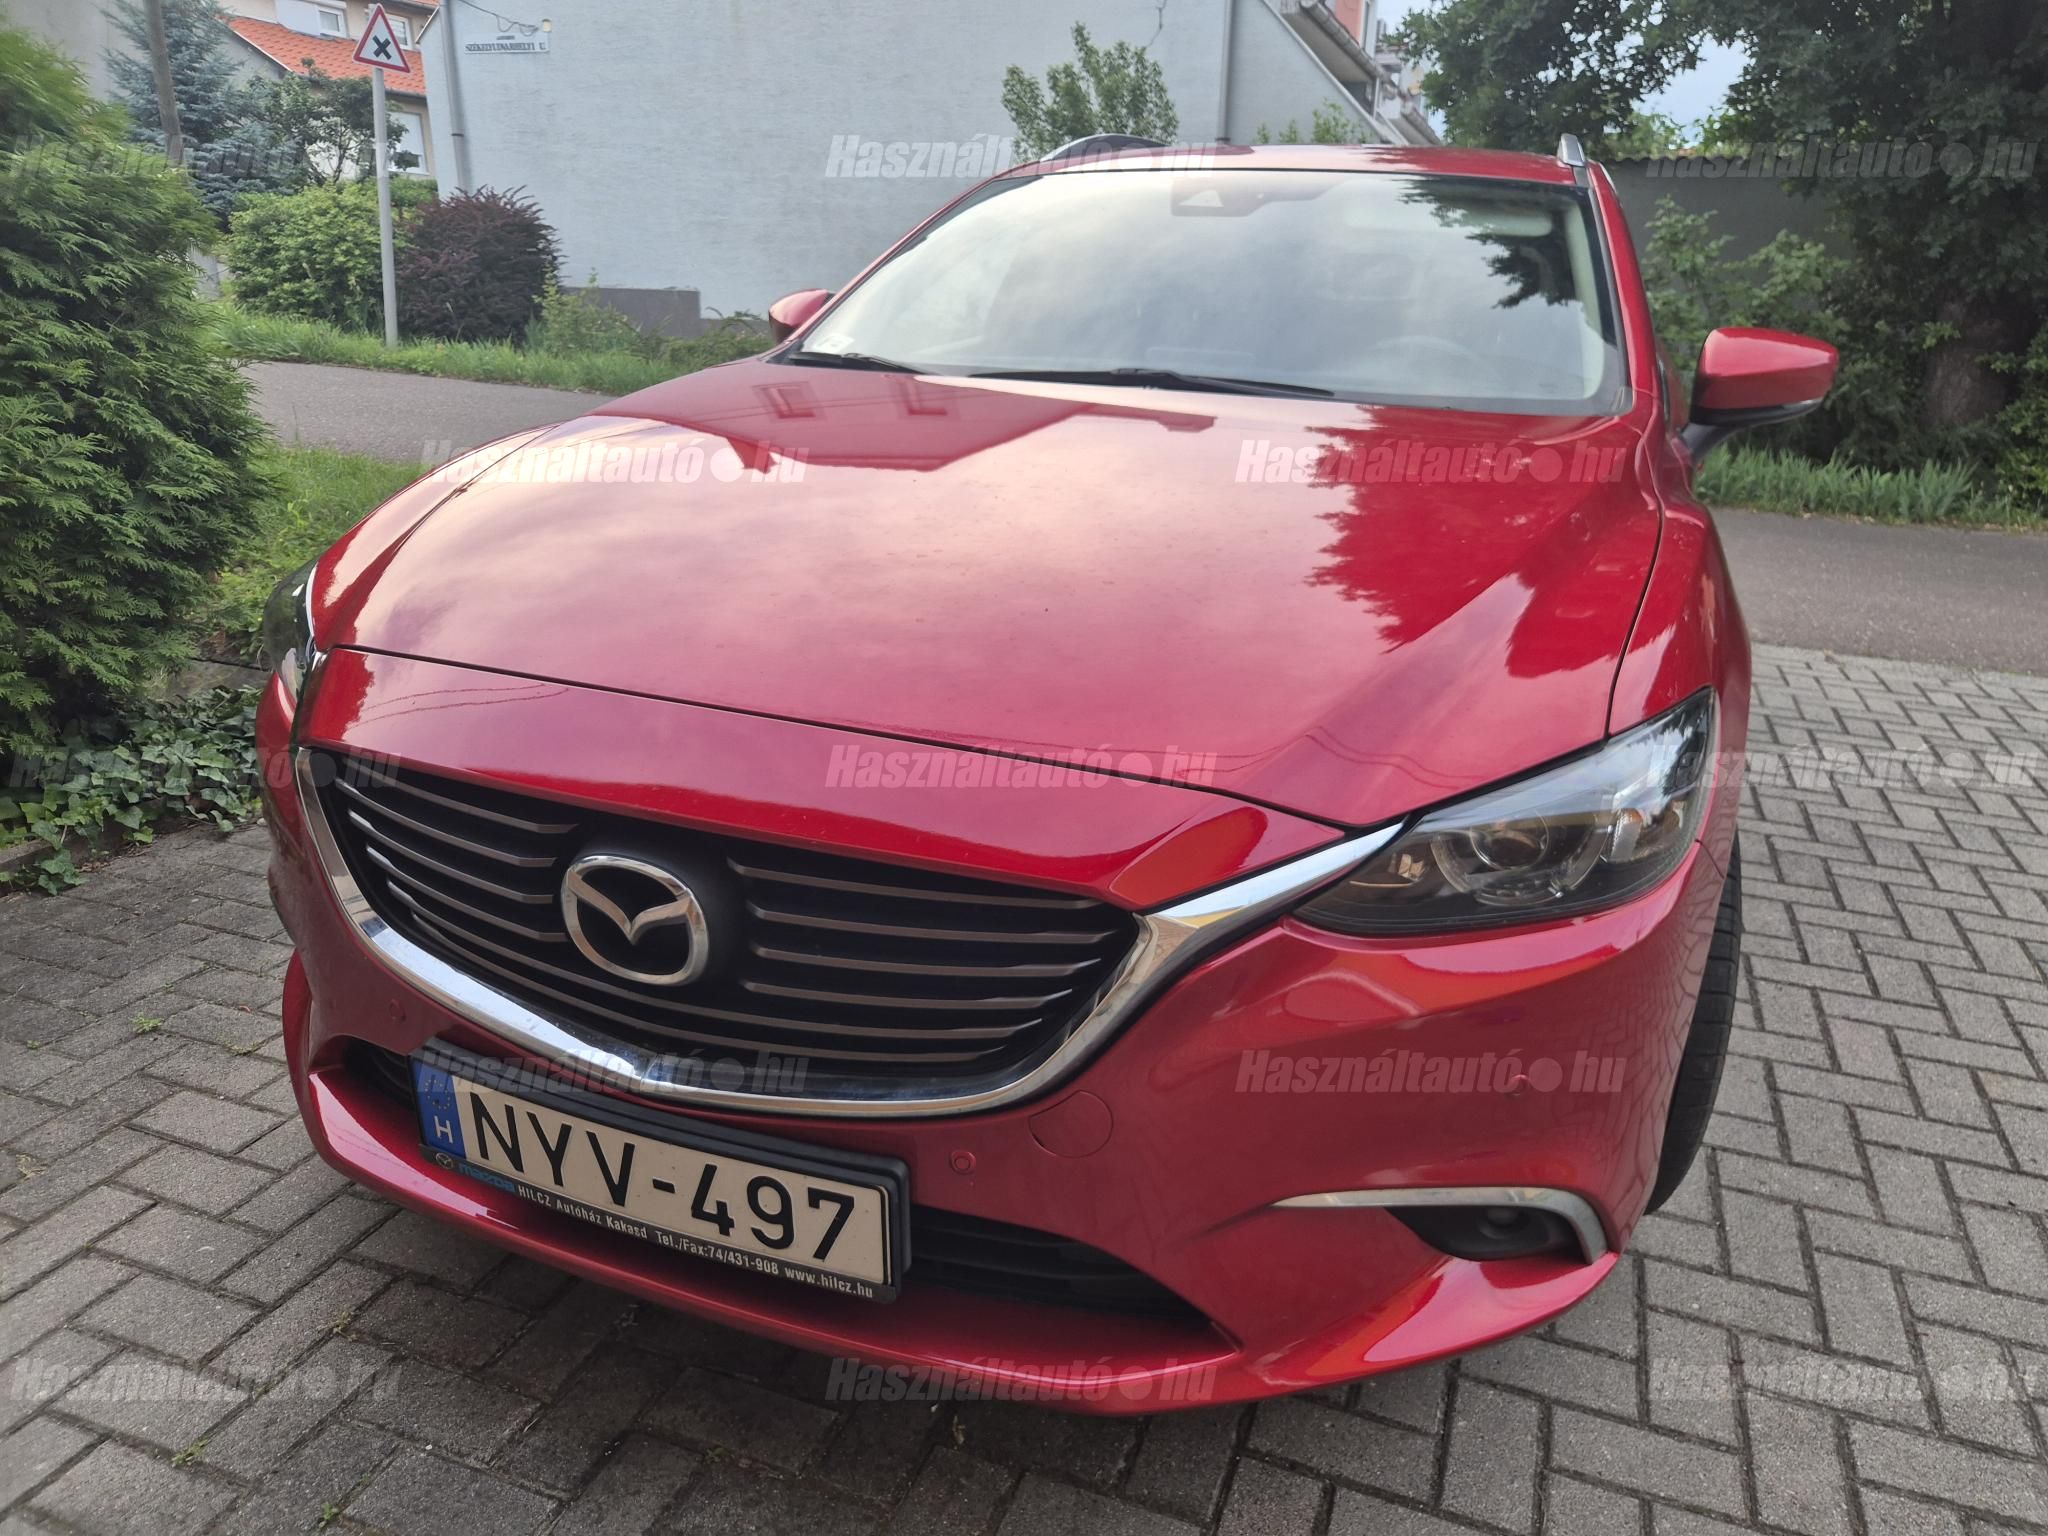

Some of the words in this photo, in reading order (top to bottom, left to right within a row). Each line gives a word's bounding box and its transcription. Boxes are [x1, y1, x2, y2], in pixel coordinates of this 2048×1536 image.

[433, 1115, 454, 1145] H
[469, 1092, 855, 1262] NYV-497
[518, 1184, 552, 1208] HILCZ
[556, 1199, 602, 1225] Autóház
[606, 1215, 648, 1239] Kakasd
[784, 1266, 874, 1299] www.hilcz.hu
